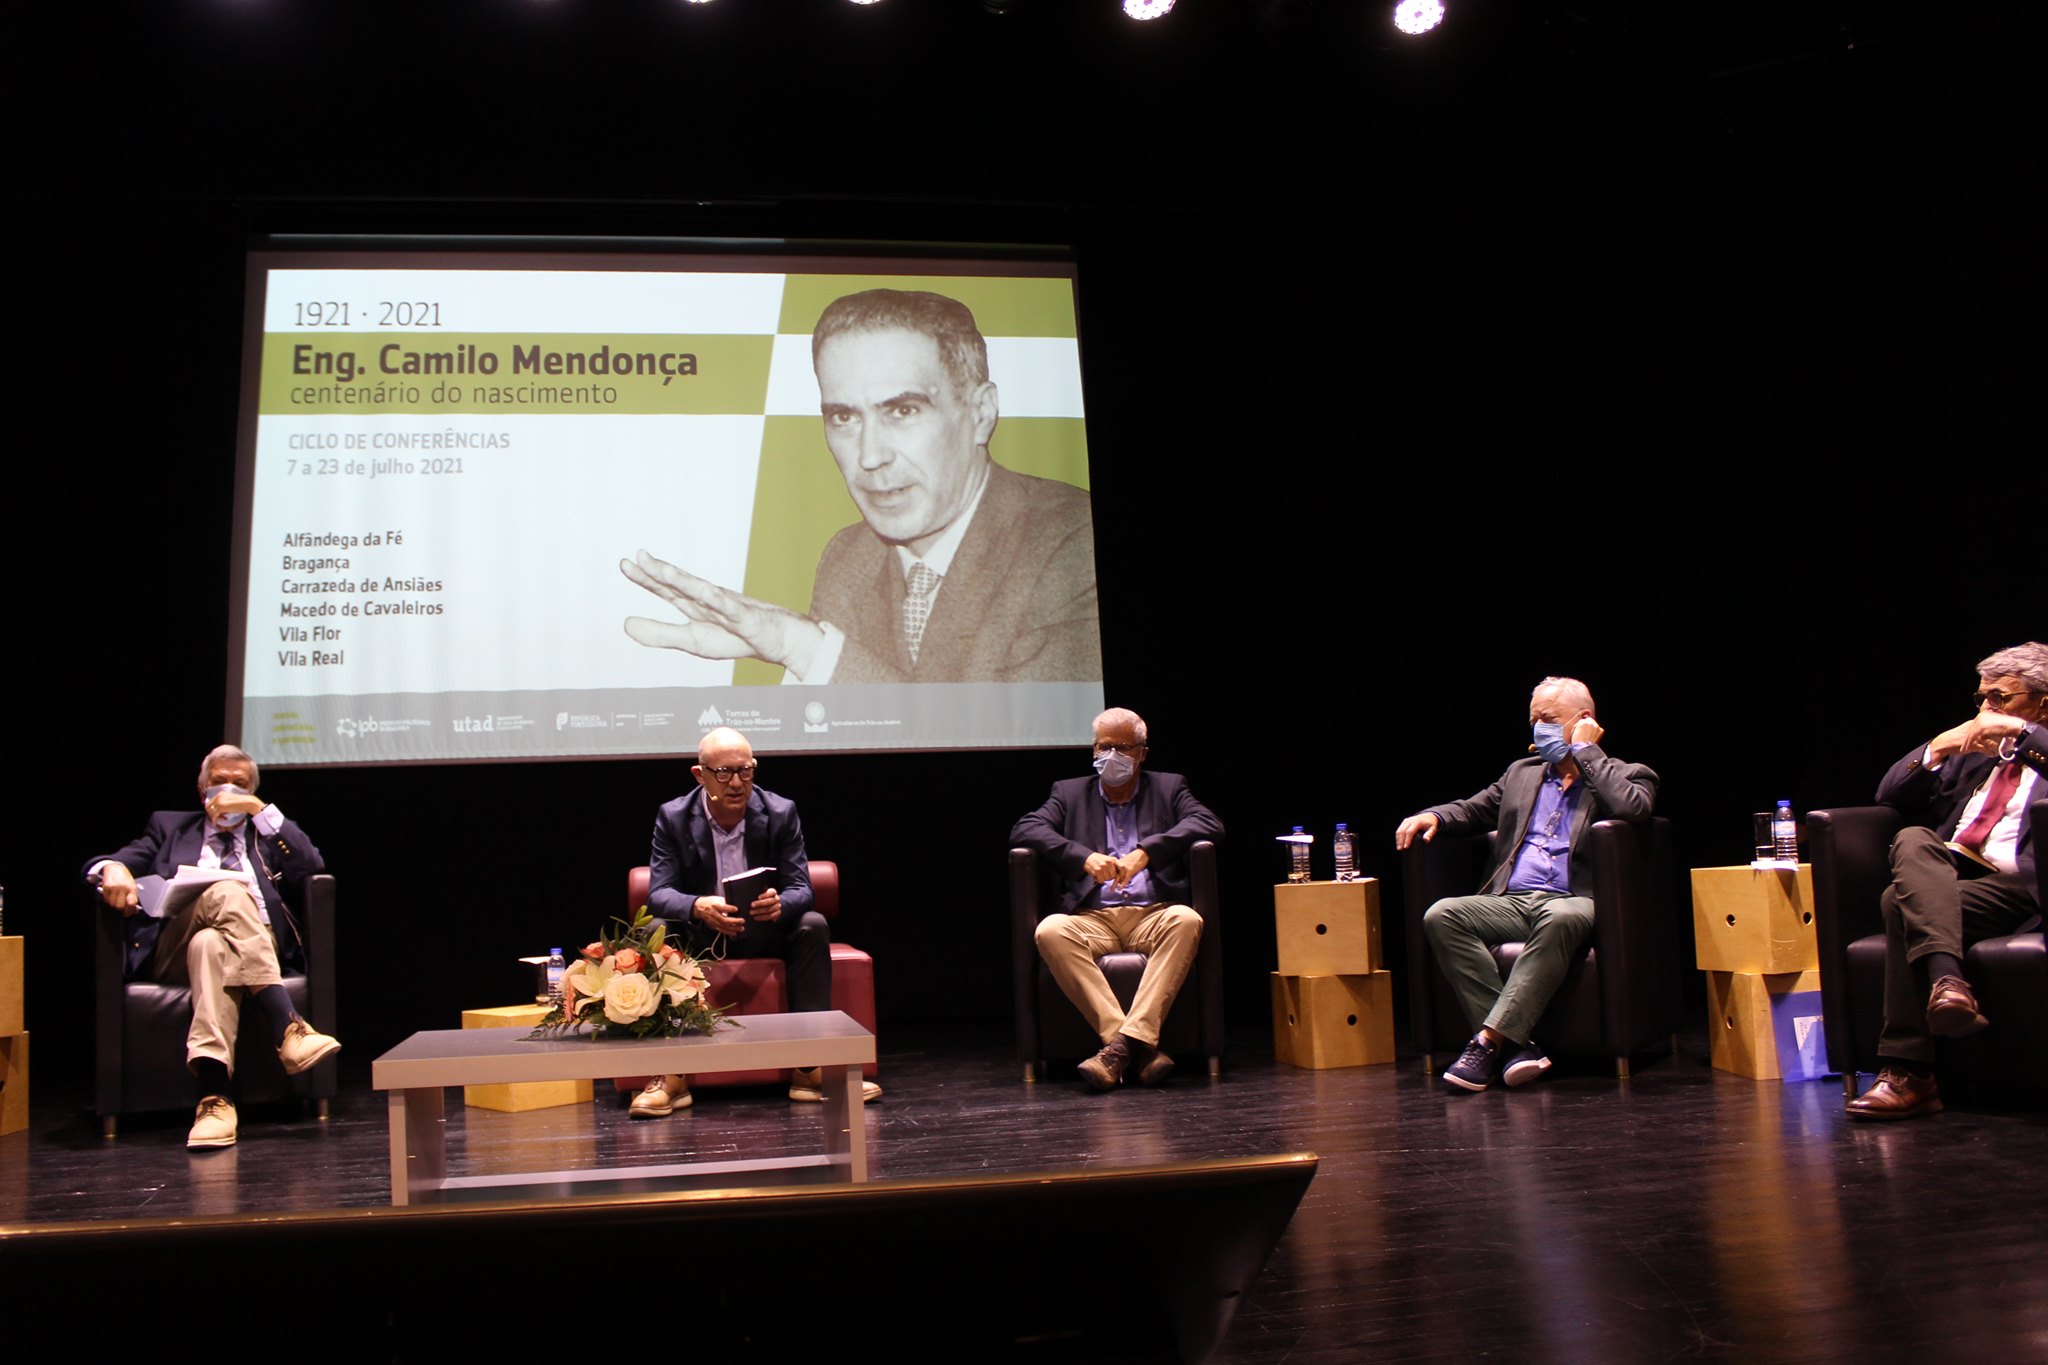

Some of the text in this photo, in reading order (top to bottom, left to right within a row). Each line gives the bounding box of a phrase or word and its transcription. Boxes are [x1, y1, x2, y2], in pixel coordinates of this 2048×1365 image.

[294, 301, 350, 326] 1921
[378, 301, 442, 326] 2021
[293, 343, 698, 386] Eng. Camilo Mendonça
[290, 381, 617, 404] centenário do nascimento
[288, 428, 511, 450] CICLO DE CONFERÊNCIAS
[286, 457, 464, 479] 7 a 23 de julho 2021
[283, 530, 403, 550] Alfândega da Fé
[282, 555, 350, 573] Bragança
[281, 576, 443, 594] Carrazeda de Ansiães
[280, 600, 443, 618] Macedo de Cavaleiros
[279, 625, 342, 642] Vila Flor
[278, 650, 344, 666] Vila Real
[452, 714, 495, 733] utad
